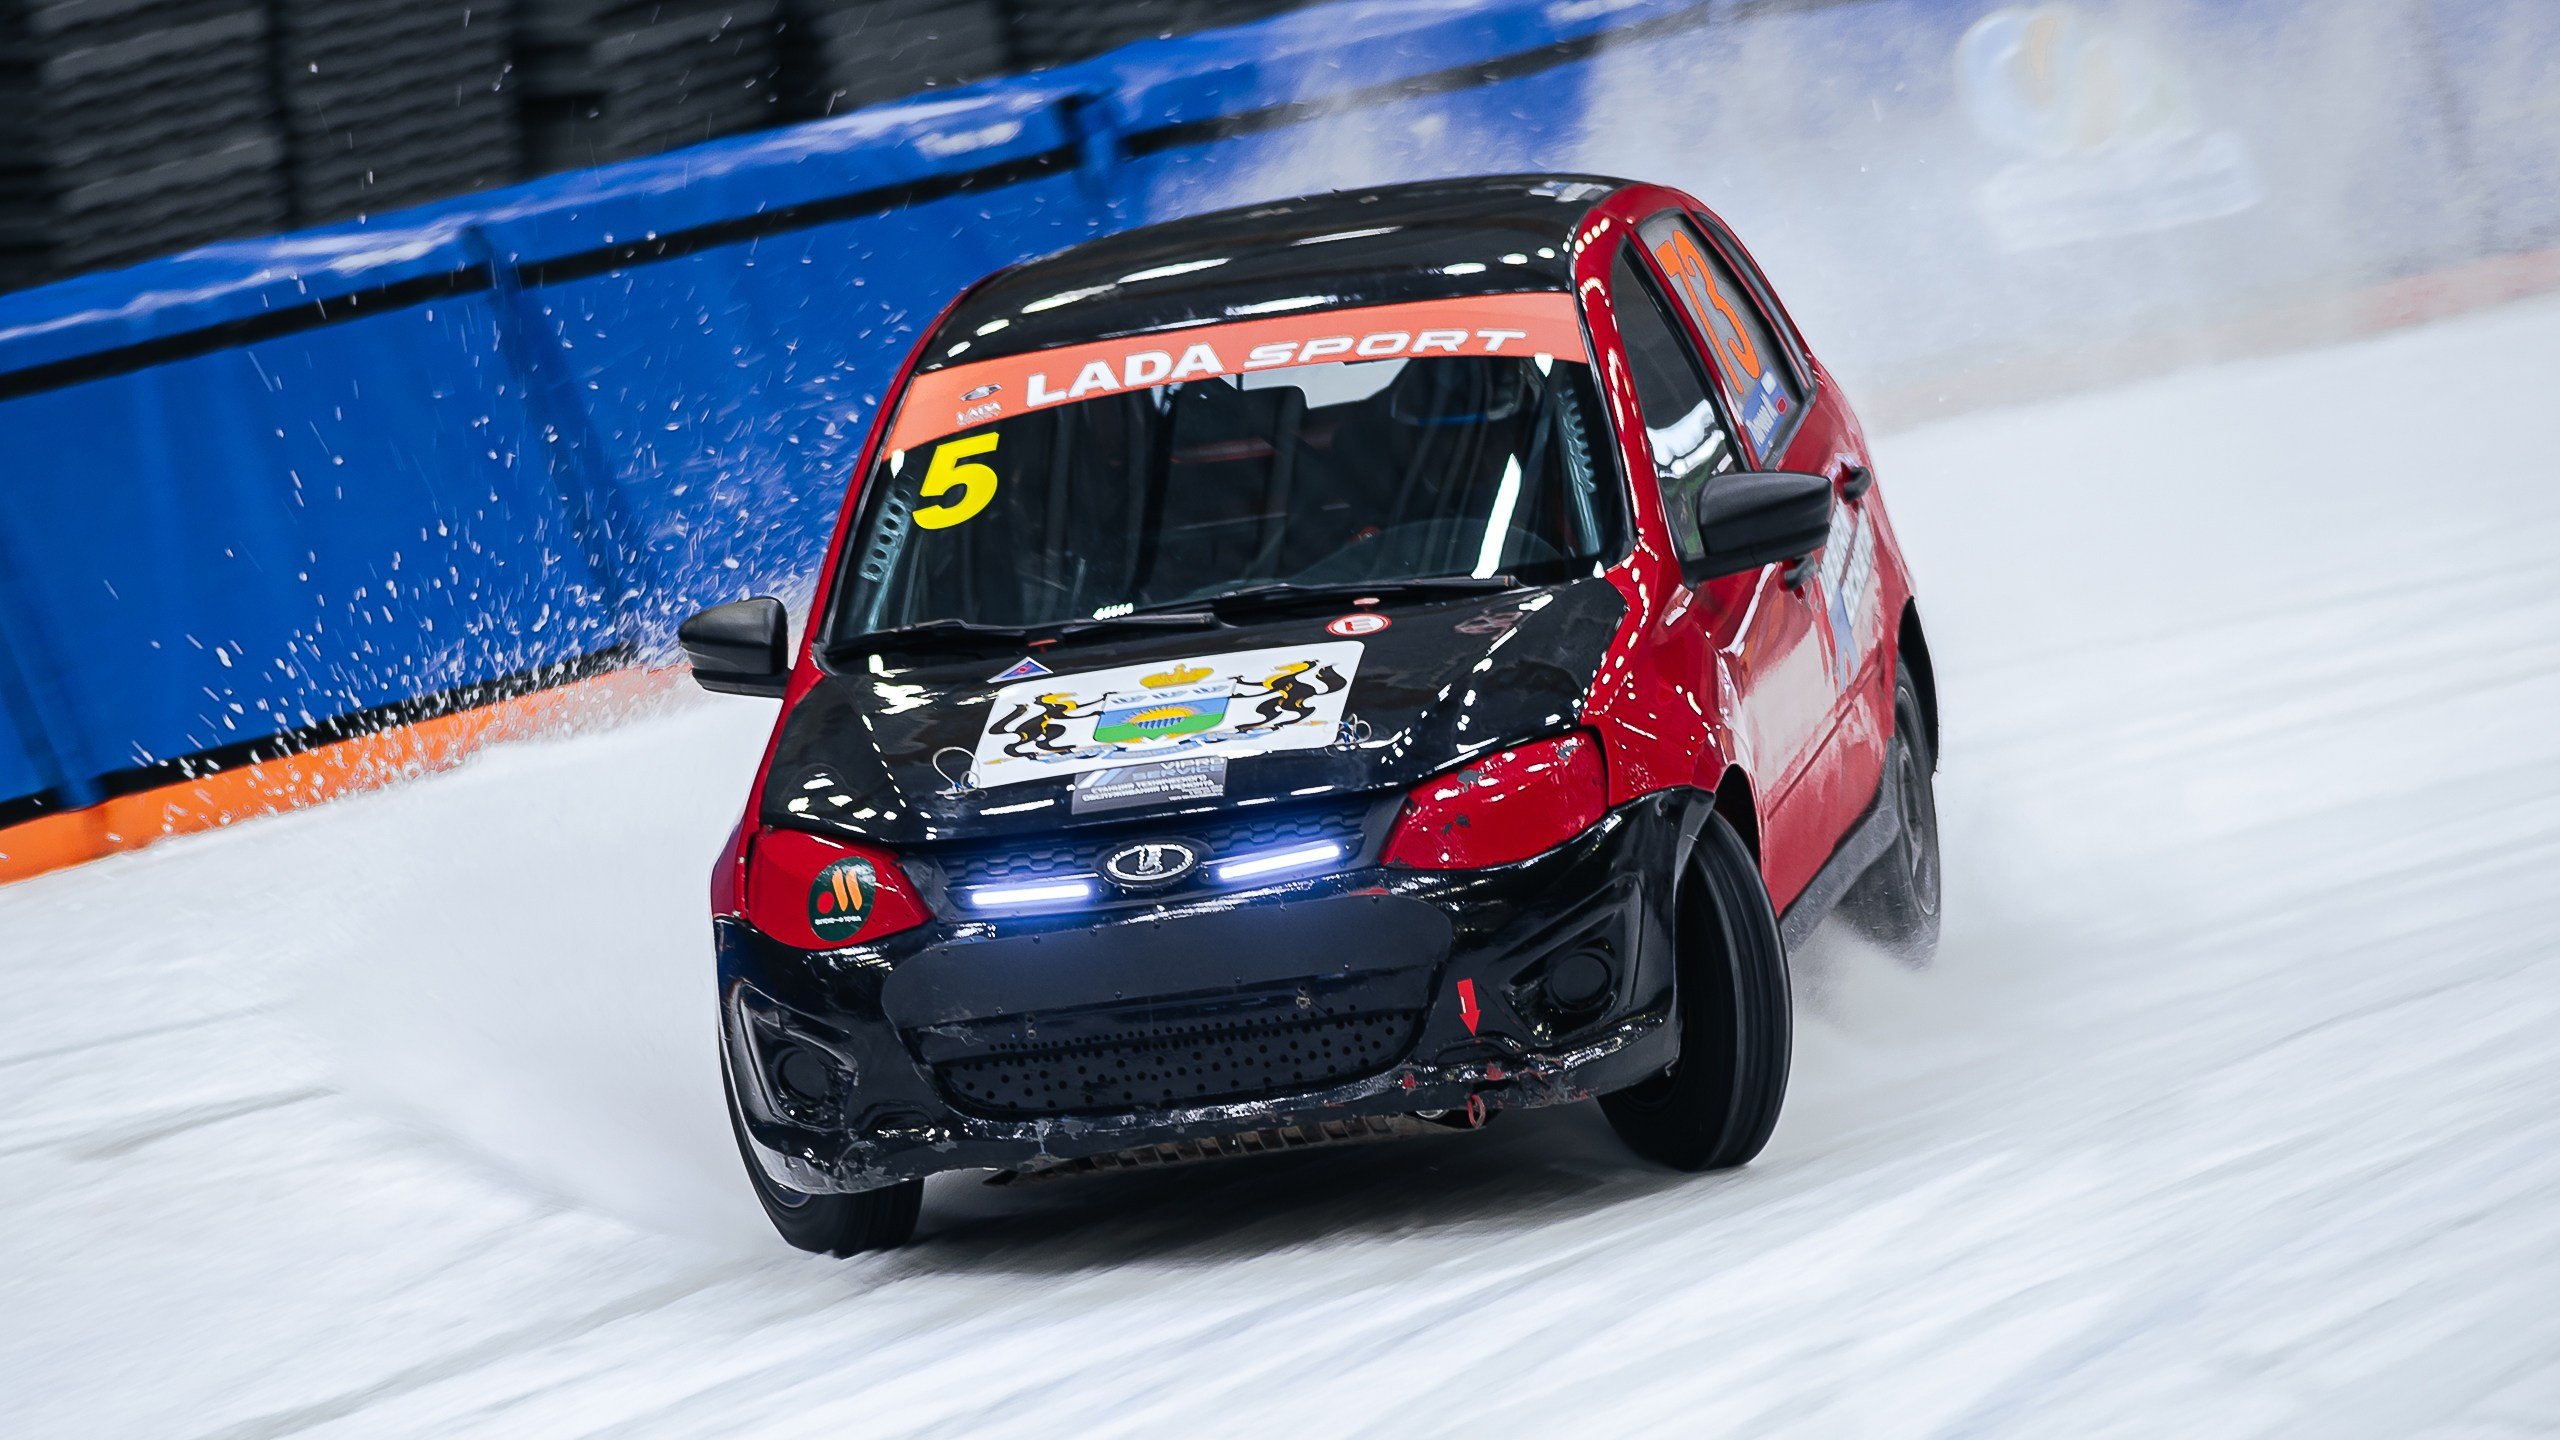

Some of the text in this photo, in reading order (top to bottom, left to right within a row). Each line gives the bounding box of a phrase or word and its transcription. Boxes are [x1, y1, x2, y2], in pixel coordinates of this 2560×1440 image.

[1654, 229, 1761, 394] 73
[1026, 329, 1528, 408] LADA SPORT
[912, 431, 1000, 530] 5
[1132, 765, 1224, 780] SERVICE
